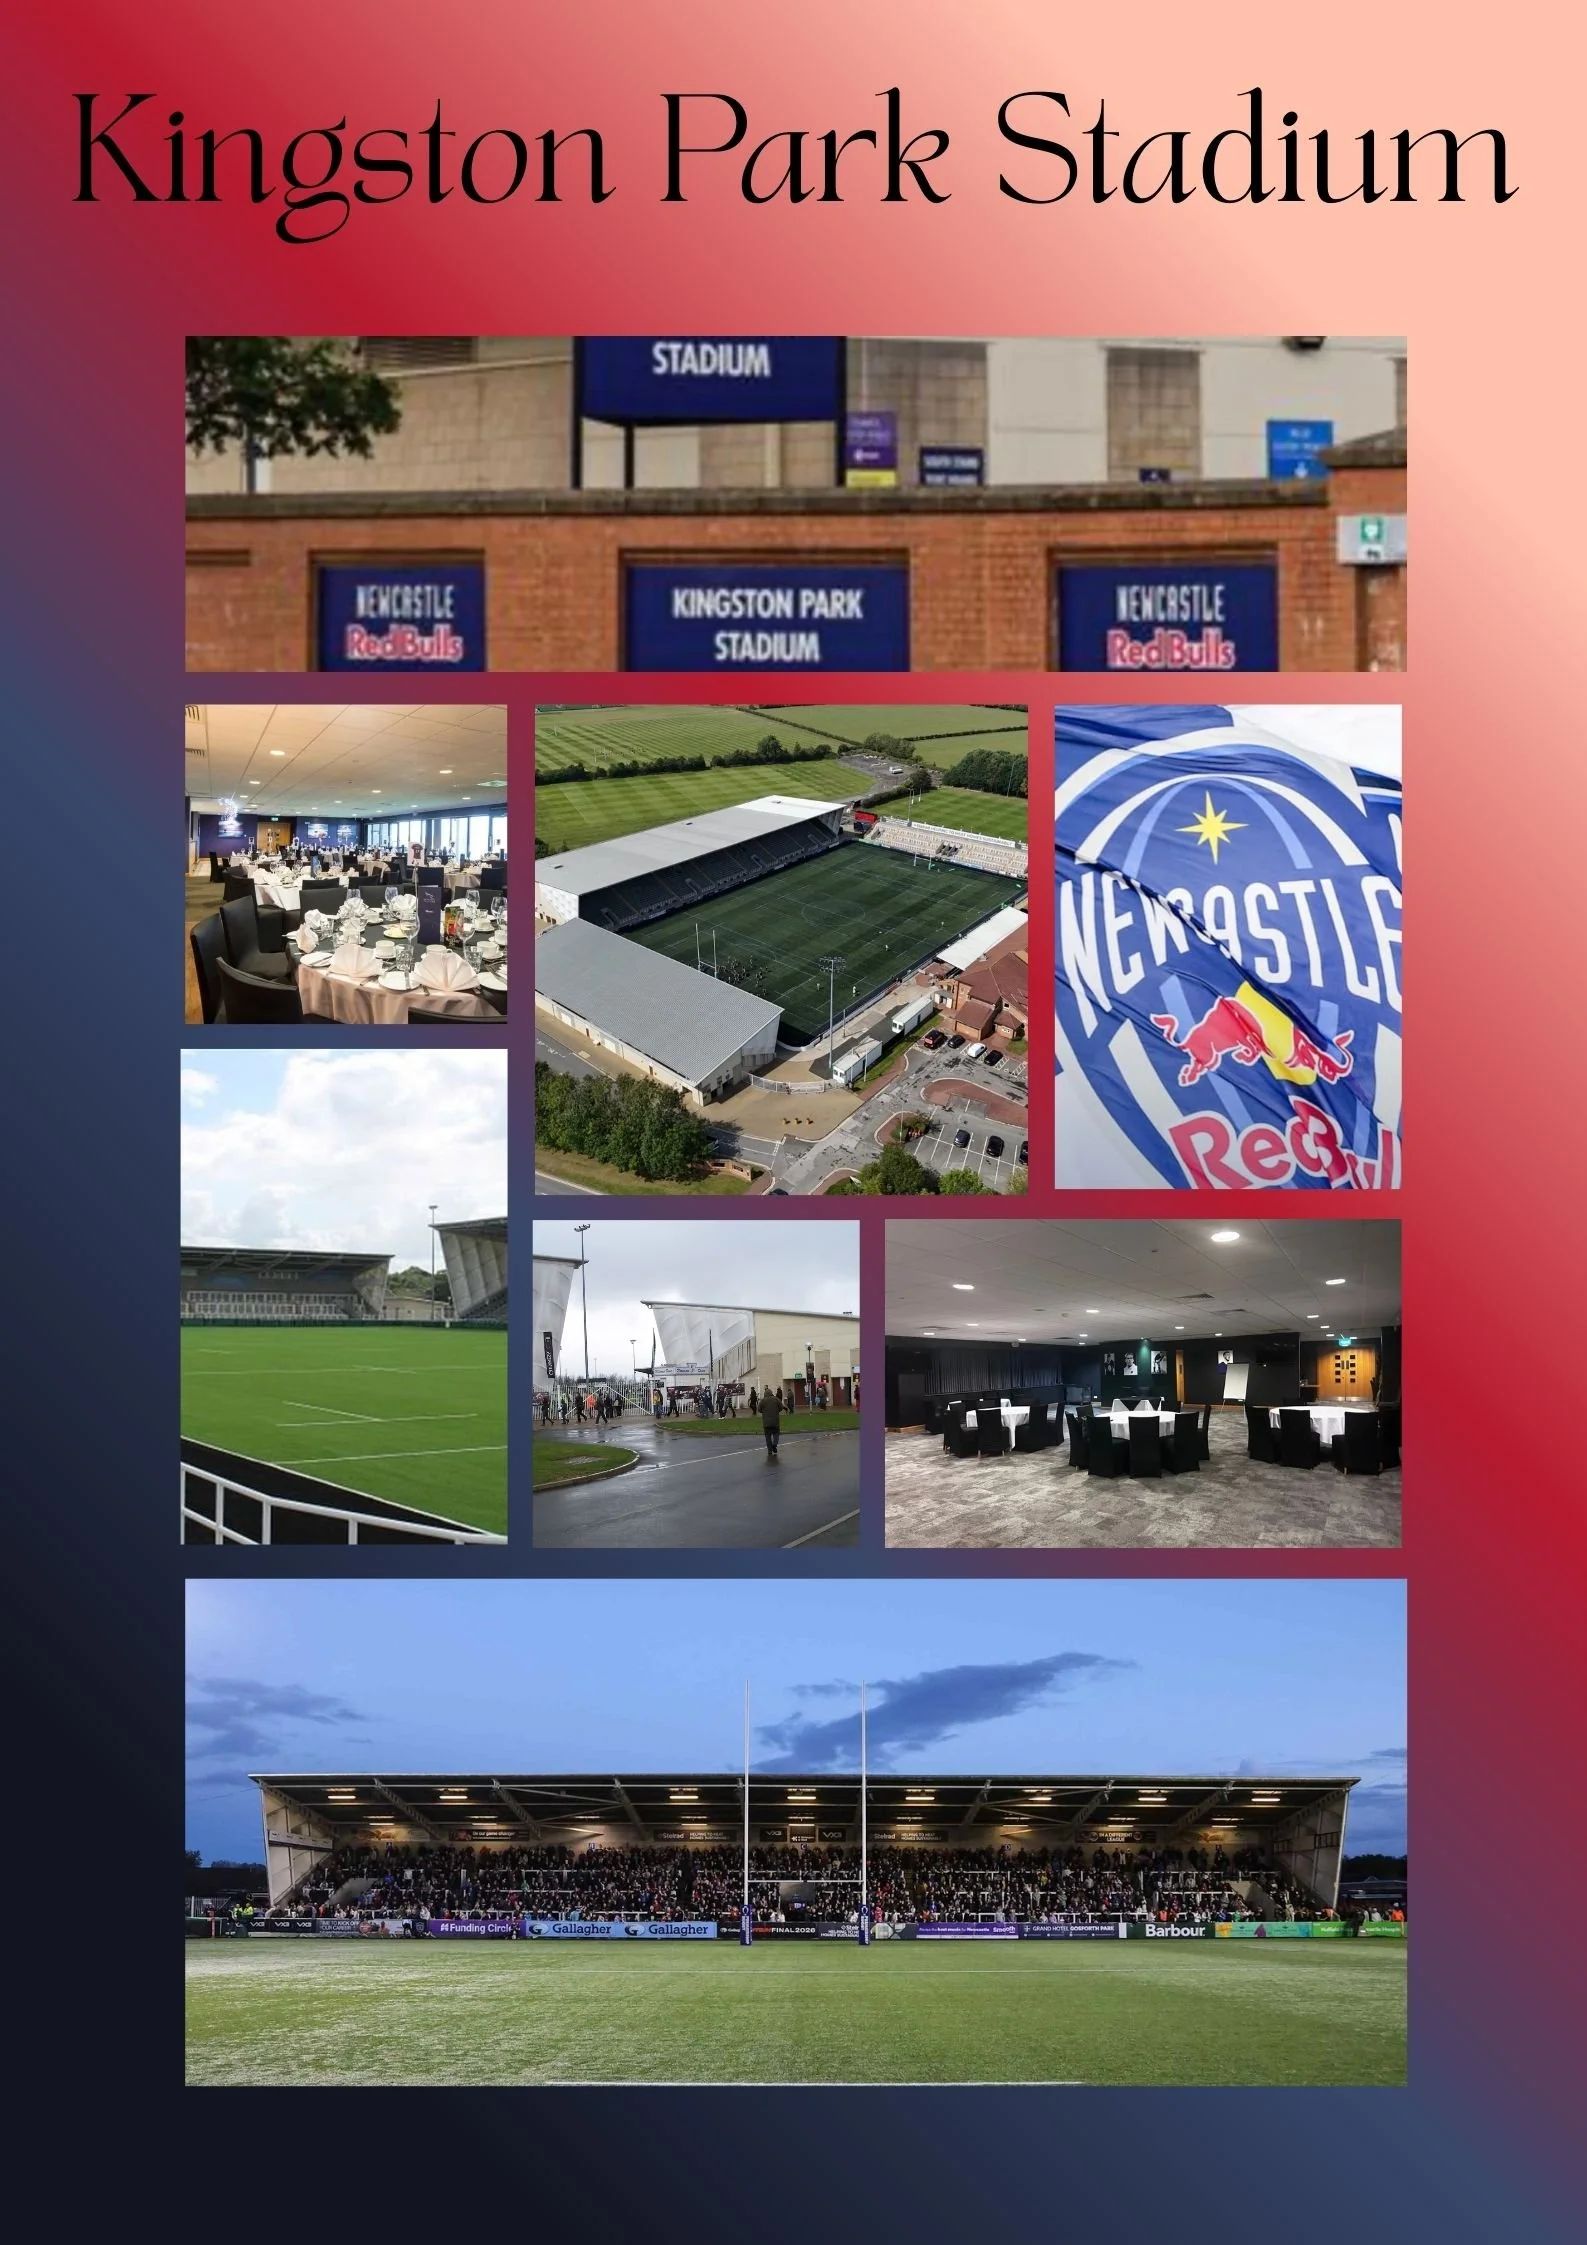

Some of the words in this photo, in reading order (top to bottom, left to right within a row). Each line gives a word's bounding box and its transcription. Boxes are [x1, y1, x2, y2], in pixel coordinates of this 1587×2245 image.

[652, 342, 771, 377] STADIUM
[355, 585, 455, 619] NEWCASTLE
[672, 587, 794, 619] KINGSTON
[799, 588, 864, 619] PARK
[1116, 584, 1226, 622] NEWCASTLE
[714, 630, 821, 663] STADIUM
[449, 1923, 486, 1935] Funding
[552, 1923, 612, 1936] Gallagher
[648, 1923, 709, 1936] Gallagher
[1145, 1923, 1205, 1937] Barbour
